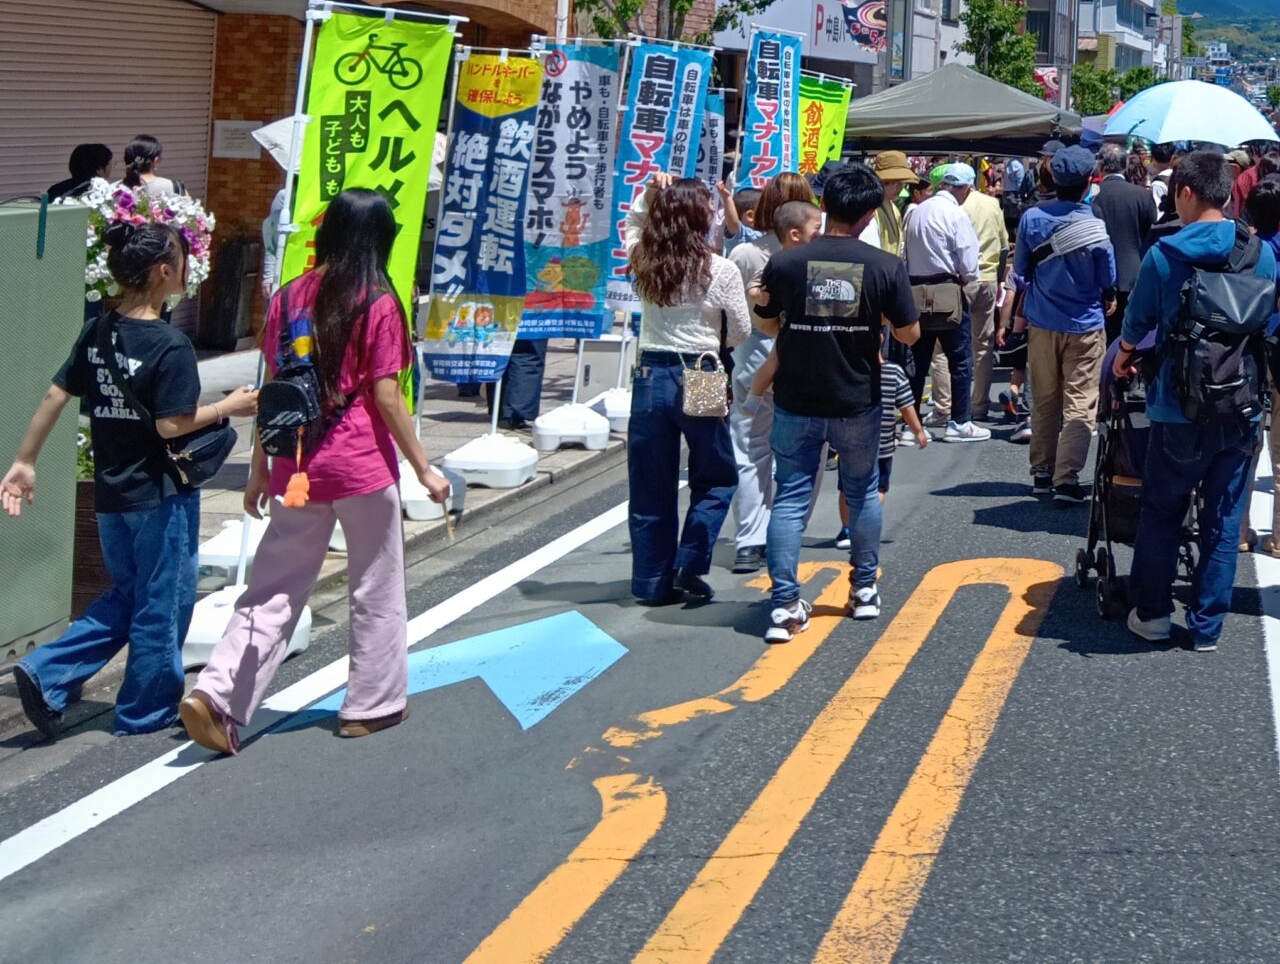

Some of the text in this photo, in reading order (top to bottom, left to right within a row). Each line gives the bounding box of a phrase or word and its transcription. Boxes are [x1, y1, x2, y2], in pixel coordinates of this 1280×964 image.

[815, 3, 825, 46] P
[466, 88, 523, 106] 確保しよう
[348, 96, 368, 148] 大人も
[564, 80, 593, 181] やめよう
[324, 120, 344, 197] 子どもも
[475, 117, 534, 275] 飲酒運転
[812, 284, 841, 294] NORTH
[825, 278, 841, 287] THE
[789, 322, 812, 332] NEVER
[813, 324, 831, 333] STOP
